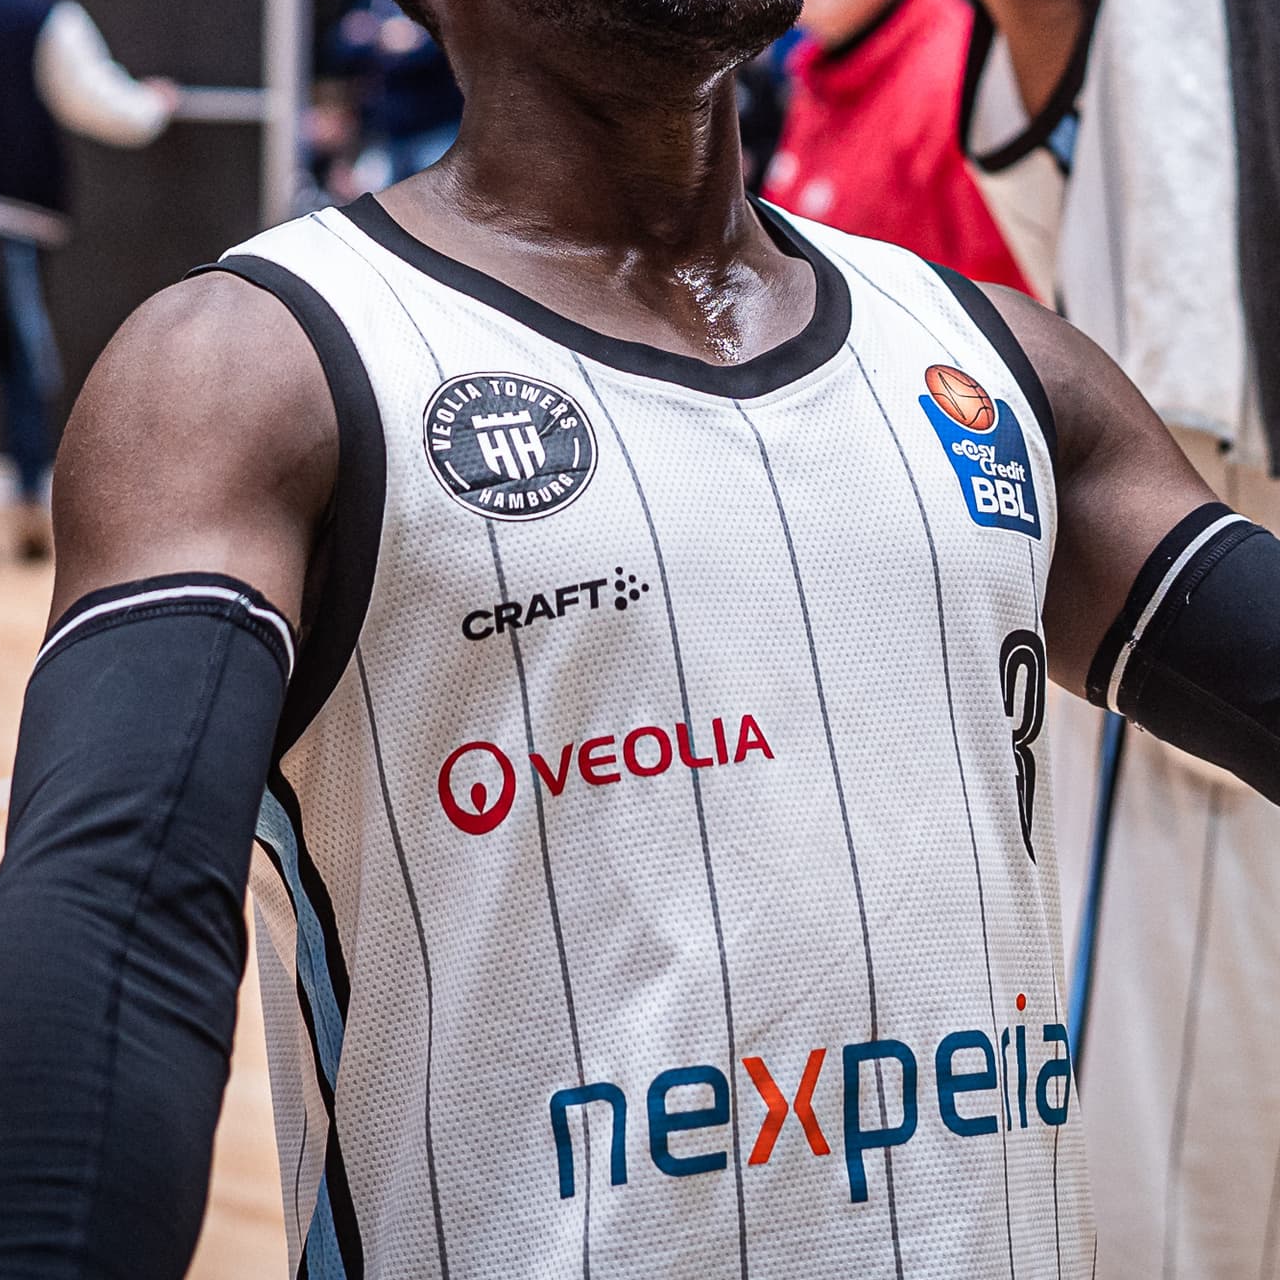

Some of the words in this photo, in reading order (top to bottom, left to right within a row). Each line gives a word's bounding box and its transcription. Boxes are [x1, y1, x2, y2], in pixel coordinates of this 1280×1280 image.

[432, 383, 482, 451] VEOLIA
[490, 381, 578, 430] TOWERS
[477, 425, 546, 480] HH
[980, 457, 1026, 483] Credit
[479, 473, 574, 509] HAMBURG
[970, 476, 1035, 524] BBL
[461, 578, 608, 641] CRAFT
[529, 714, 775, 796] VEOLIA
[549, 993, 1072, 1203] nexperia
